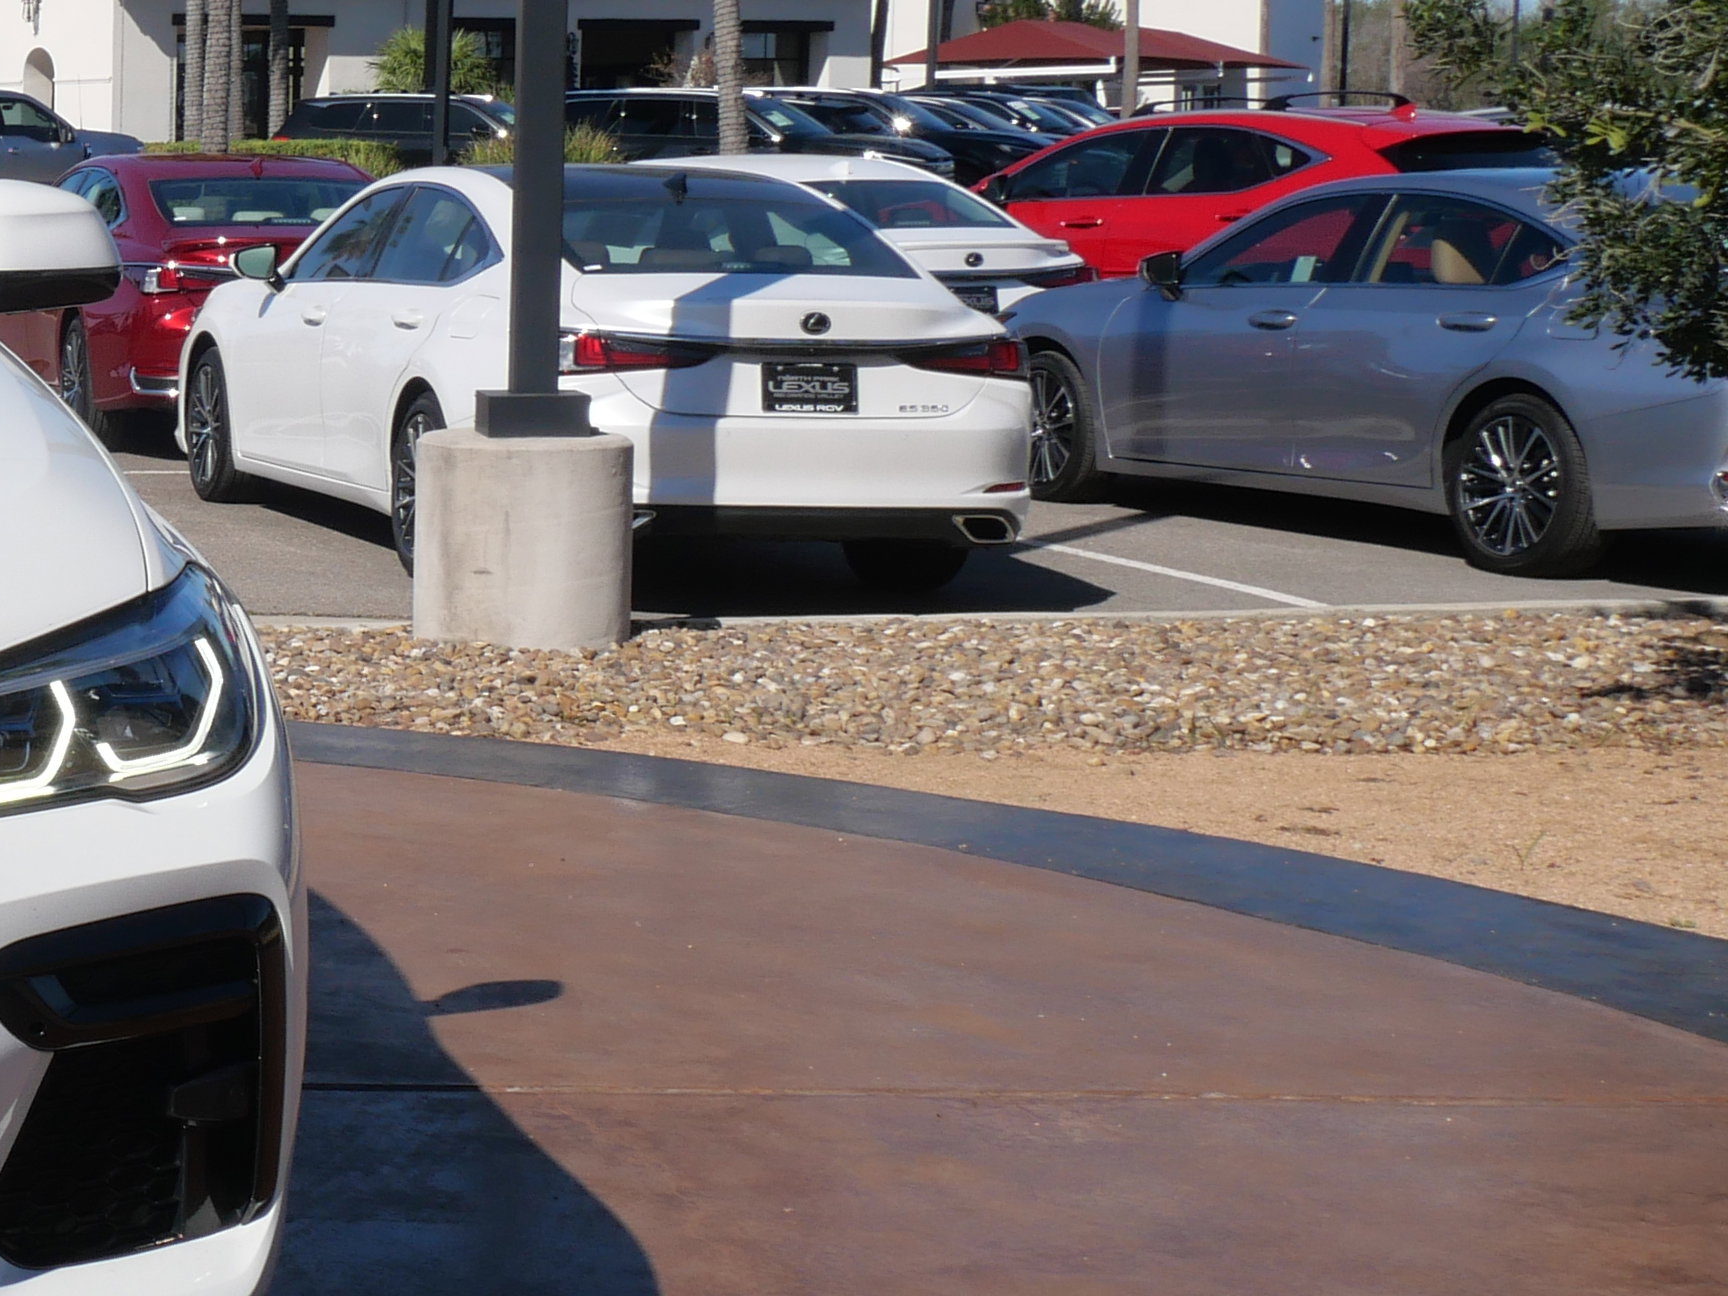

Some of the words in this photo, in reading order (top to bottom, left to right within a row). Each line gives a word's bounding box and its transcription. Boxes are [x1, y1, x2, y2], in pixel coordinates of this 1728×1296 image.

[768, 380, 850, 394] LEXUS
[774, 403, 814, 412] LEXUS
[816, 404, 845, 412] RGV
[899, 405, 918, 413] ES
[921, 405, 949, 413] 350
